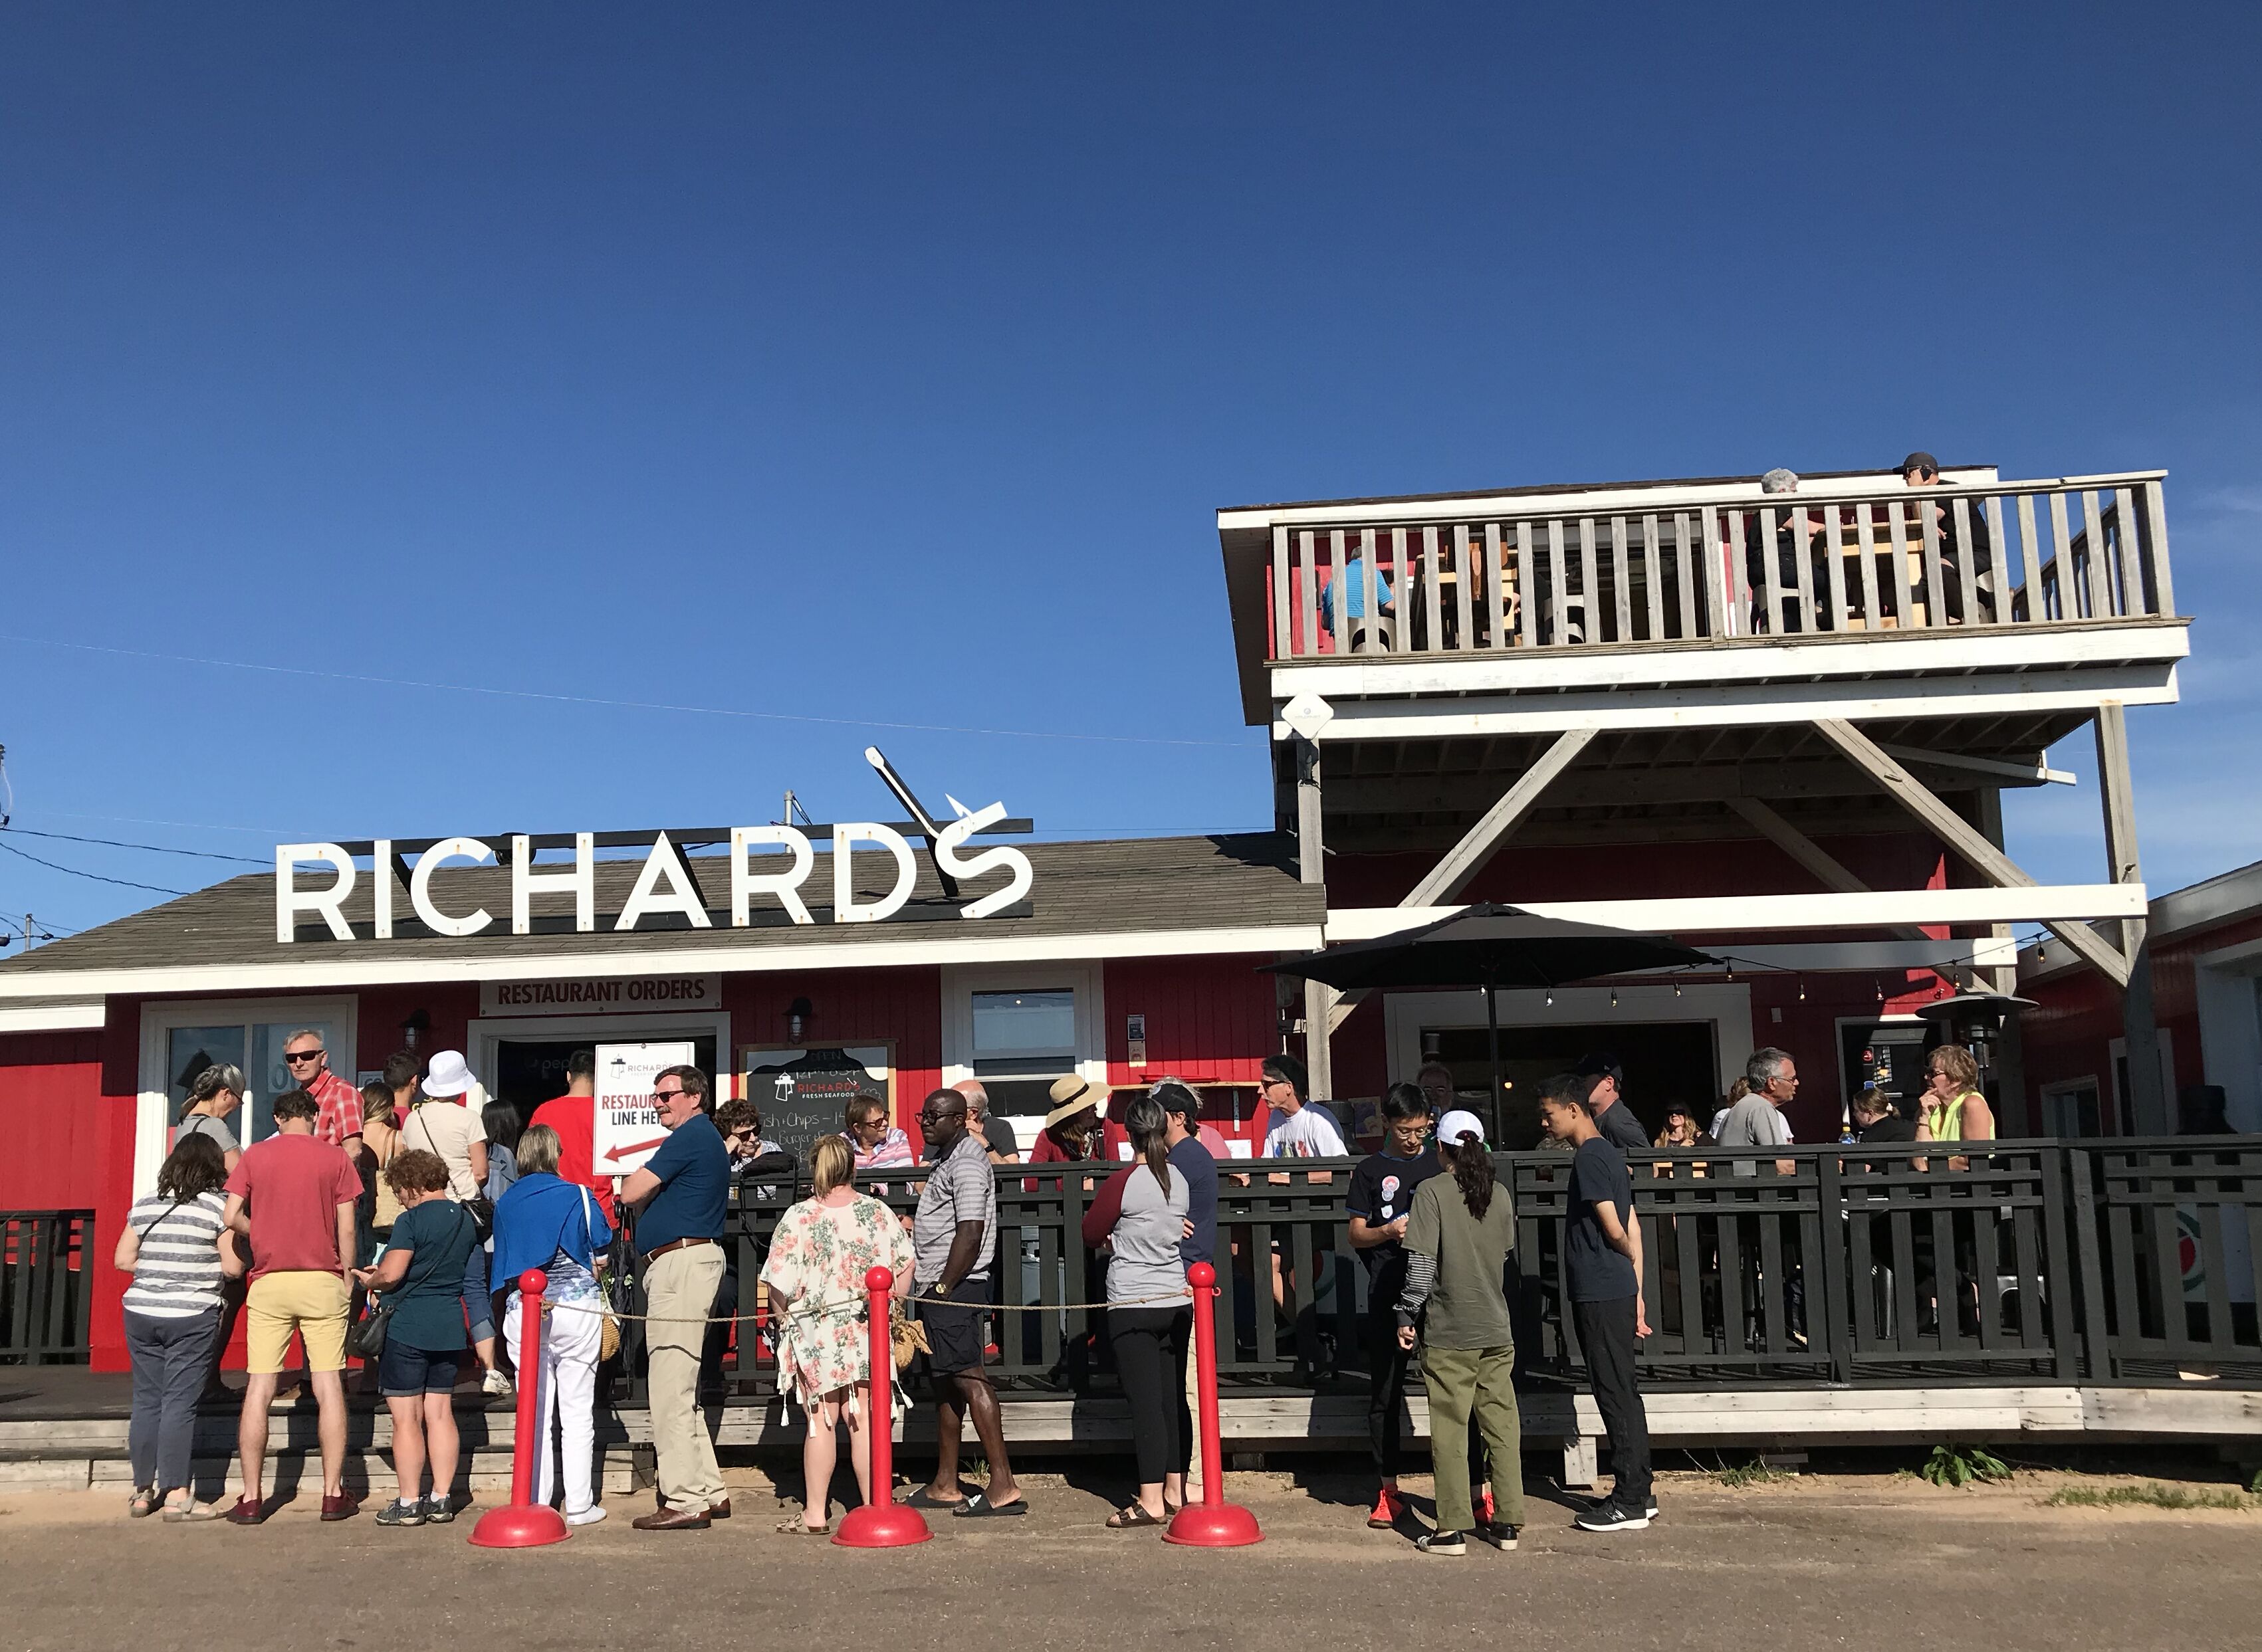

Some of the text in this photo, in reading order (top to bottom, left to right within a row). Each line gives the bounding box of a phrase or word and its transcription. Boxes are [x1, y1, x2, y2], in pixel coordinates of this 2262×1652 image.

[499, 979, 705, 1005] RESTAURANT ORDERS
[612, 1111, 637, 1126] LINE
